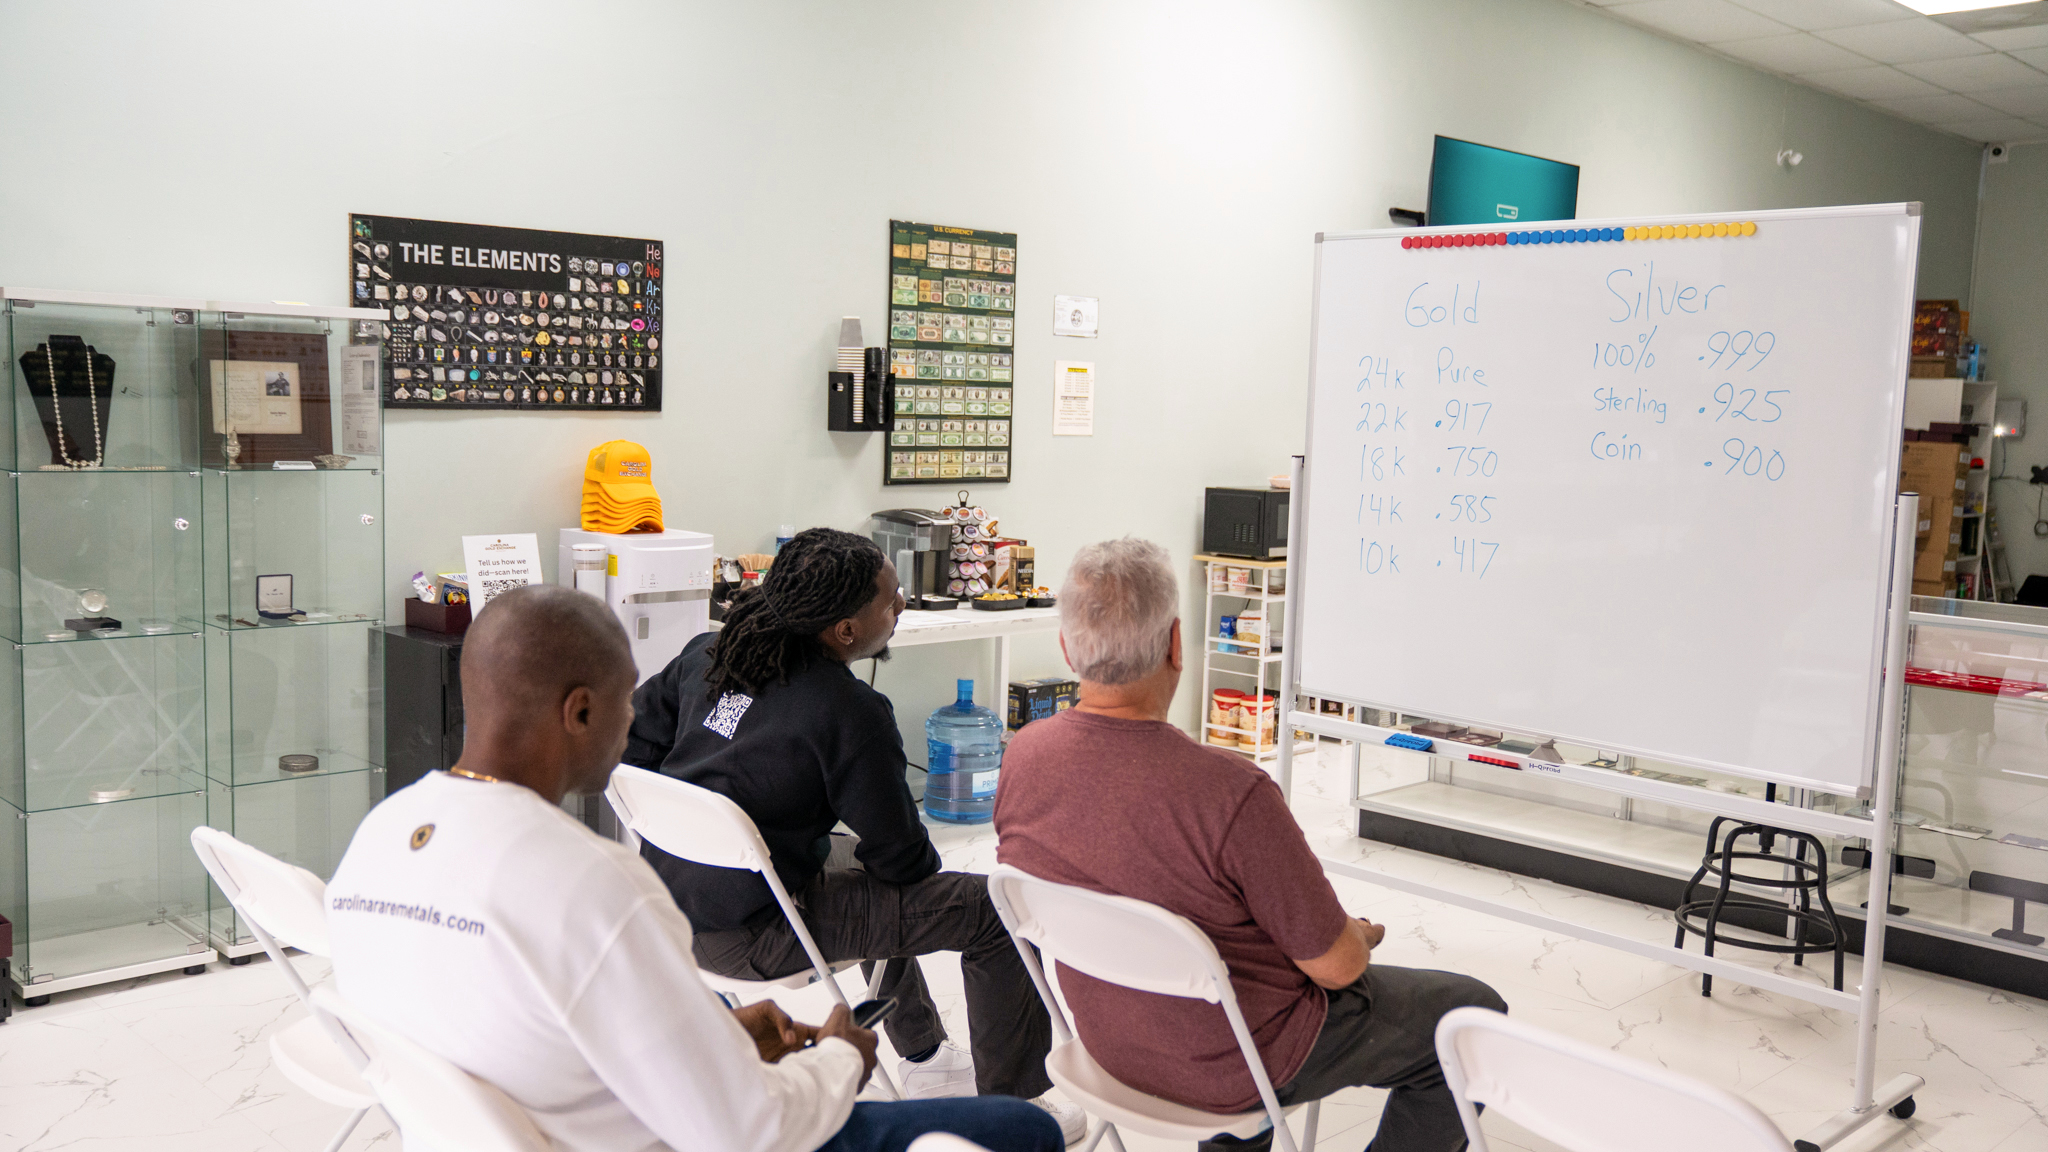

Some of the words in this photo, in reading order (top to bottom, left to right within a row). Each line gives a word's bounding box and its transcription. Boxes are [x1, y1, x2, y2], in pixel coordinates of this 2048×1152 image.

[945, 227, 974, 236] CURRENCY
[399, 242, 444, 265] THE
[451, 246, 562, 273] ELEMENTS
[646, 244, 661, 261] He
[646, 263, 660, 278] Ne
[646, 280, 660, 296] Ar
[1404, 280, 1481, 328] Gold
[1605, 260, 1727, 323] Silver
[646, 298, 660, 315] Kr
[646, 316, 660, 332] Xe
[1593, 325, 1658, 374] 100%
[1697, 330, 1776, 372] .999
[1436, 346, 1490, 388] Pure
[1434, 399, 1493, 435] .917
[1593, 386, 1667, 424] Sterling
[1697, 382, 1791, 423] .925
[1435, 446, 1499, 478] .750
[1590, 431, 1642, 461] Coin
[1703, 437, 1786, 482] .900
[1435, 494, 1498, 523] .585
[1436, 535, 1500, 580] .417
[1028, 696, 1053, 713] Liquid
[332, 894, 485, 935] carolinararemetals.com
